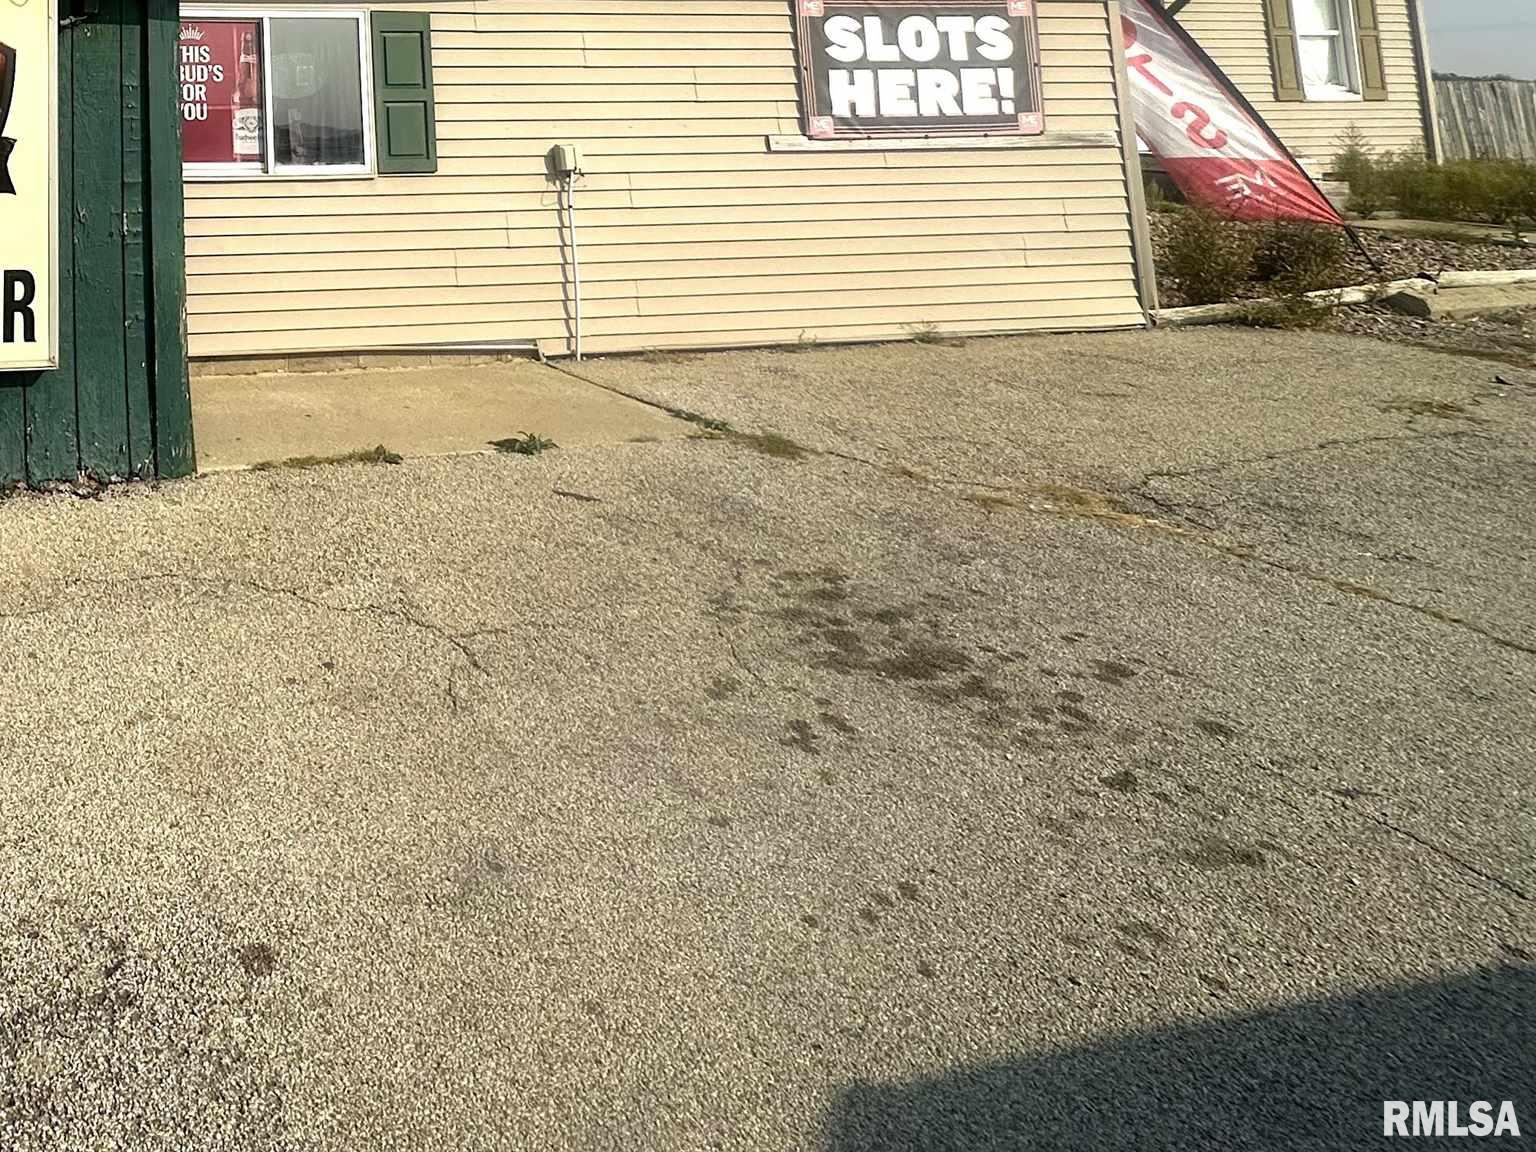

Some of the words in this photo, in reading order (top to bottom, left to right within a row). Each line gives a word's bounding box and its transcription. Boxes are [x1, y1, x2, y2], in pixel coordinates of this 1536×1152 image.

[823, 15, 1014, 63] SLOTS
[180, 45, 211, 63] HIS
[181, 83, 207, 101] OR
[828, 67, 1015, 118] HERE!
[181, 103, 207, 121] OU
